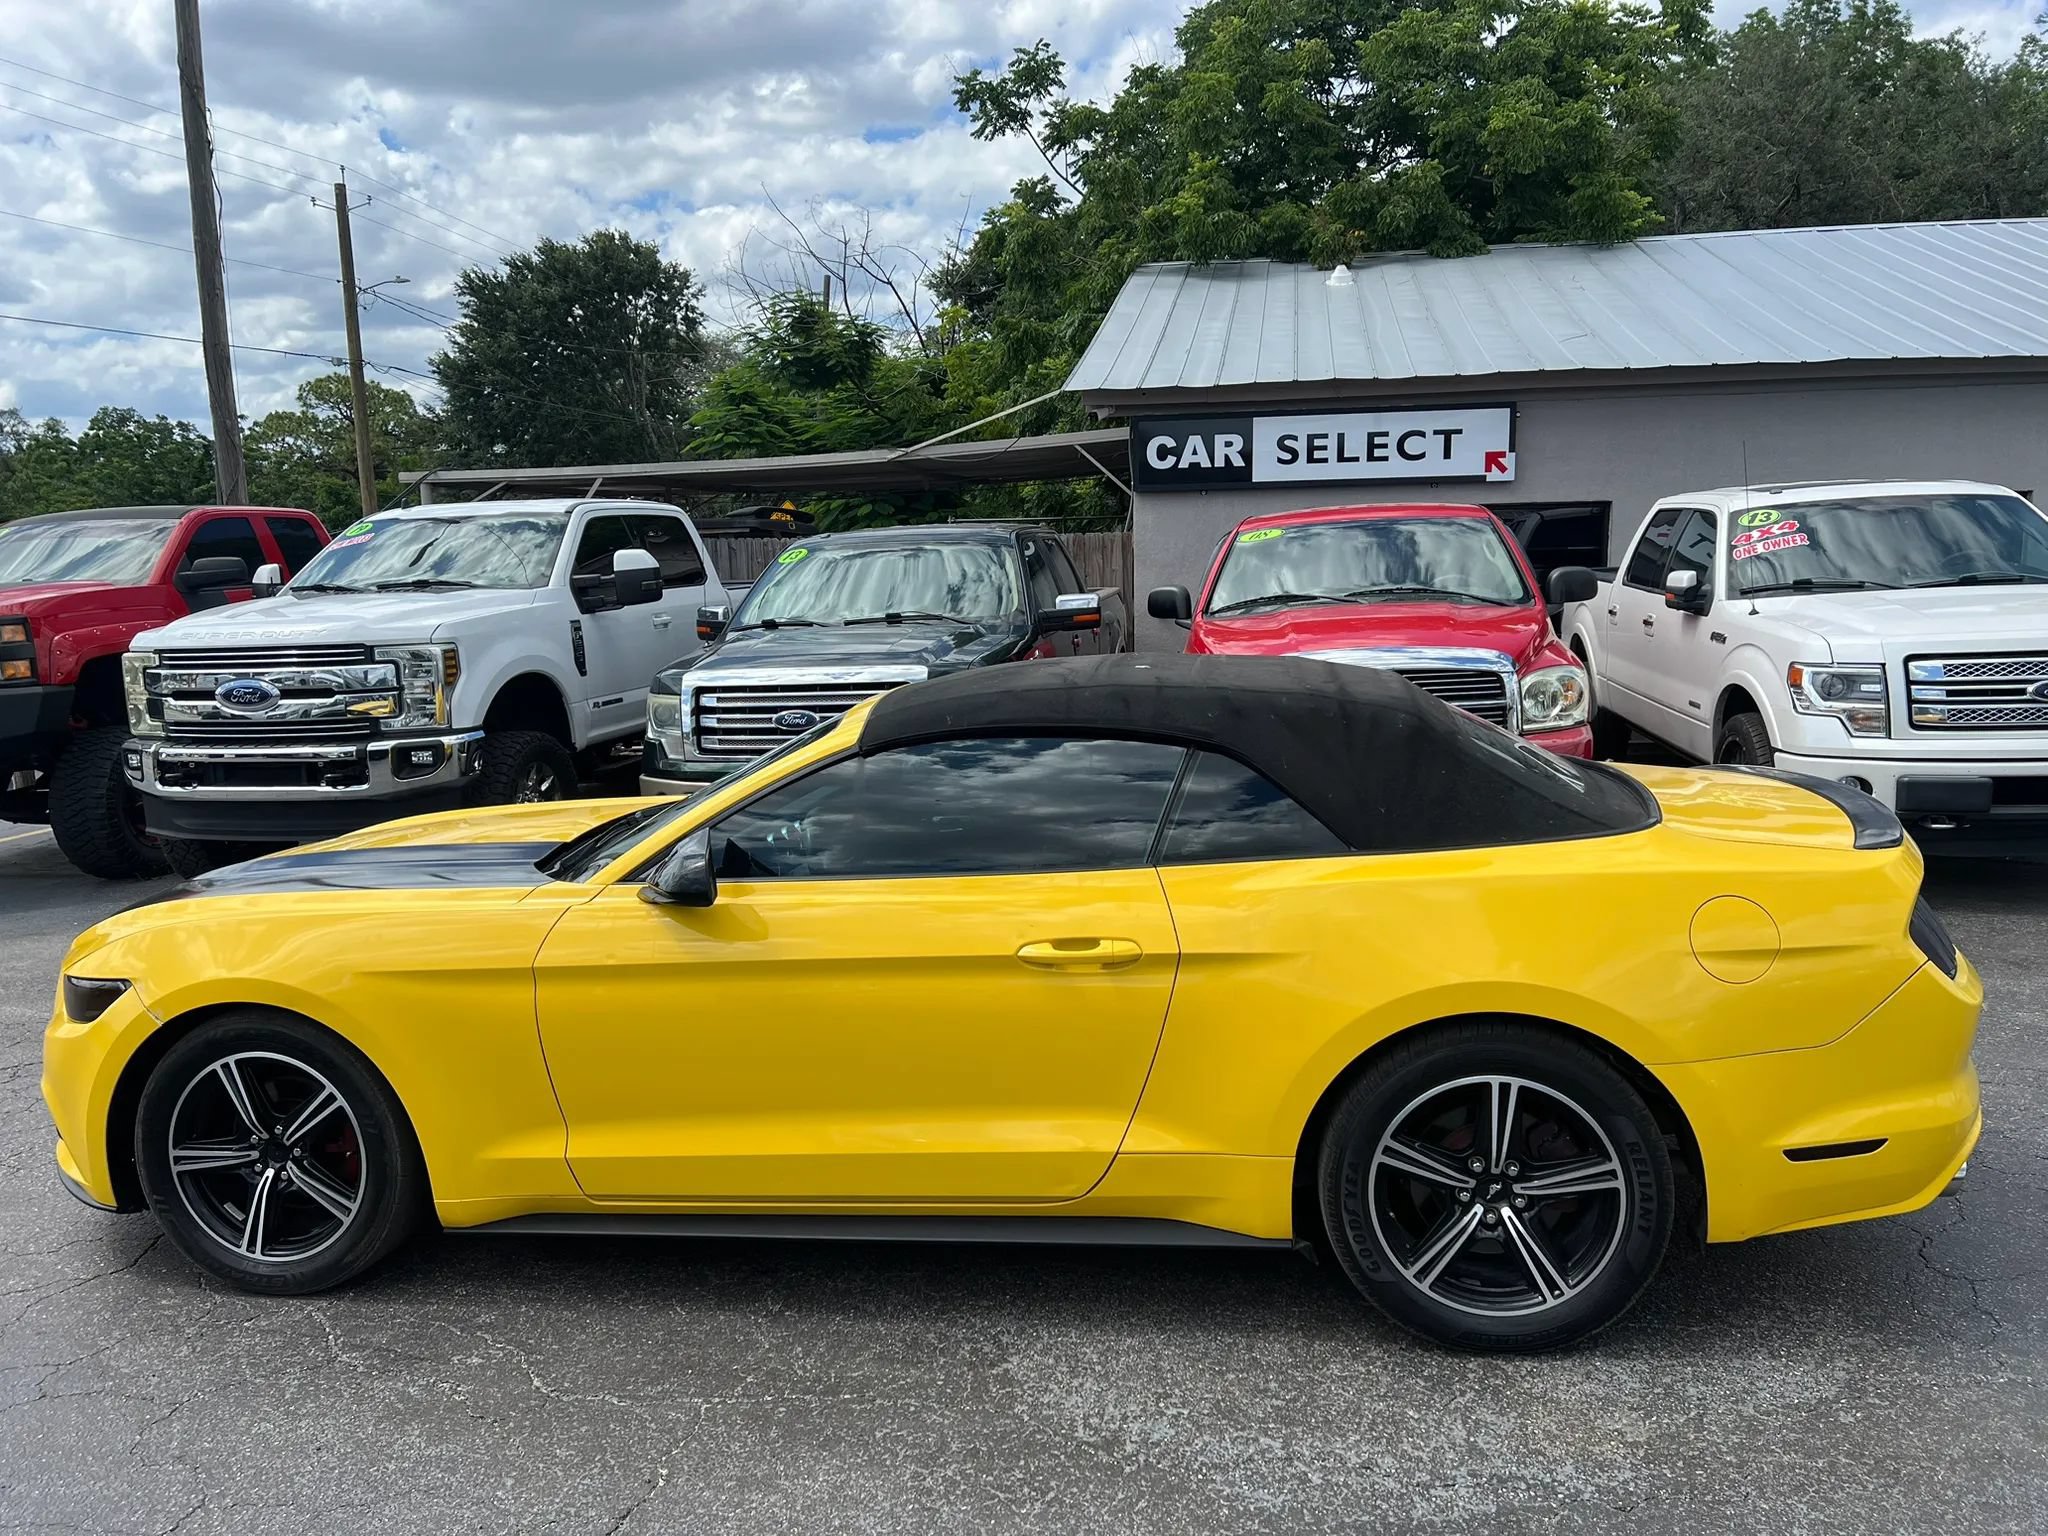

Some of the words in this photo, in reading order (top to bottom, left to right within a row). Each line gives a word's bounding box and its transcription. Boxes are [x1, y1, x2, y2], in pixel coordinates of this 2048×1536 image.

[1146, 433, 1246, 470] CAR
[1276, 428, 1464, 465] SELECT
[1747, 511, 1773, 525] 13
[1734, 544, 1759, 559] ONE
[1762, 534, 1808, 551] OWNER
[781, 550, 804, 562] 13
[180, 631, 257, 640] SUPER
[259, 628, 328, 638] DUTY
[230, 688, 261, 703] Ford
[781, 713, 808, 726] Ford
[1343, 1160, 1382, 1274] GOODYEA
